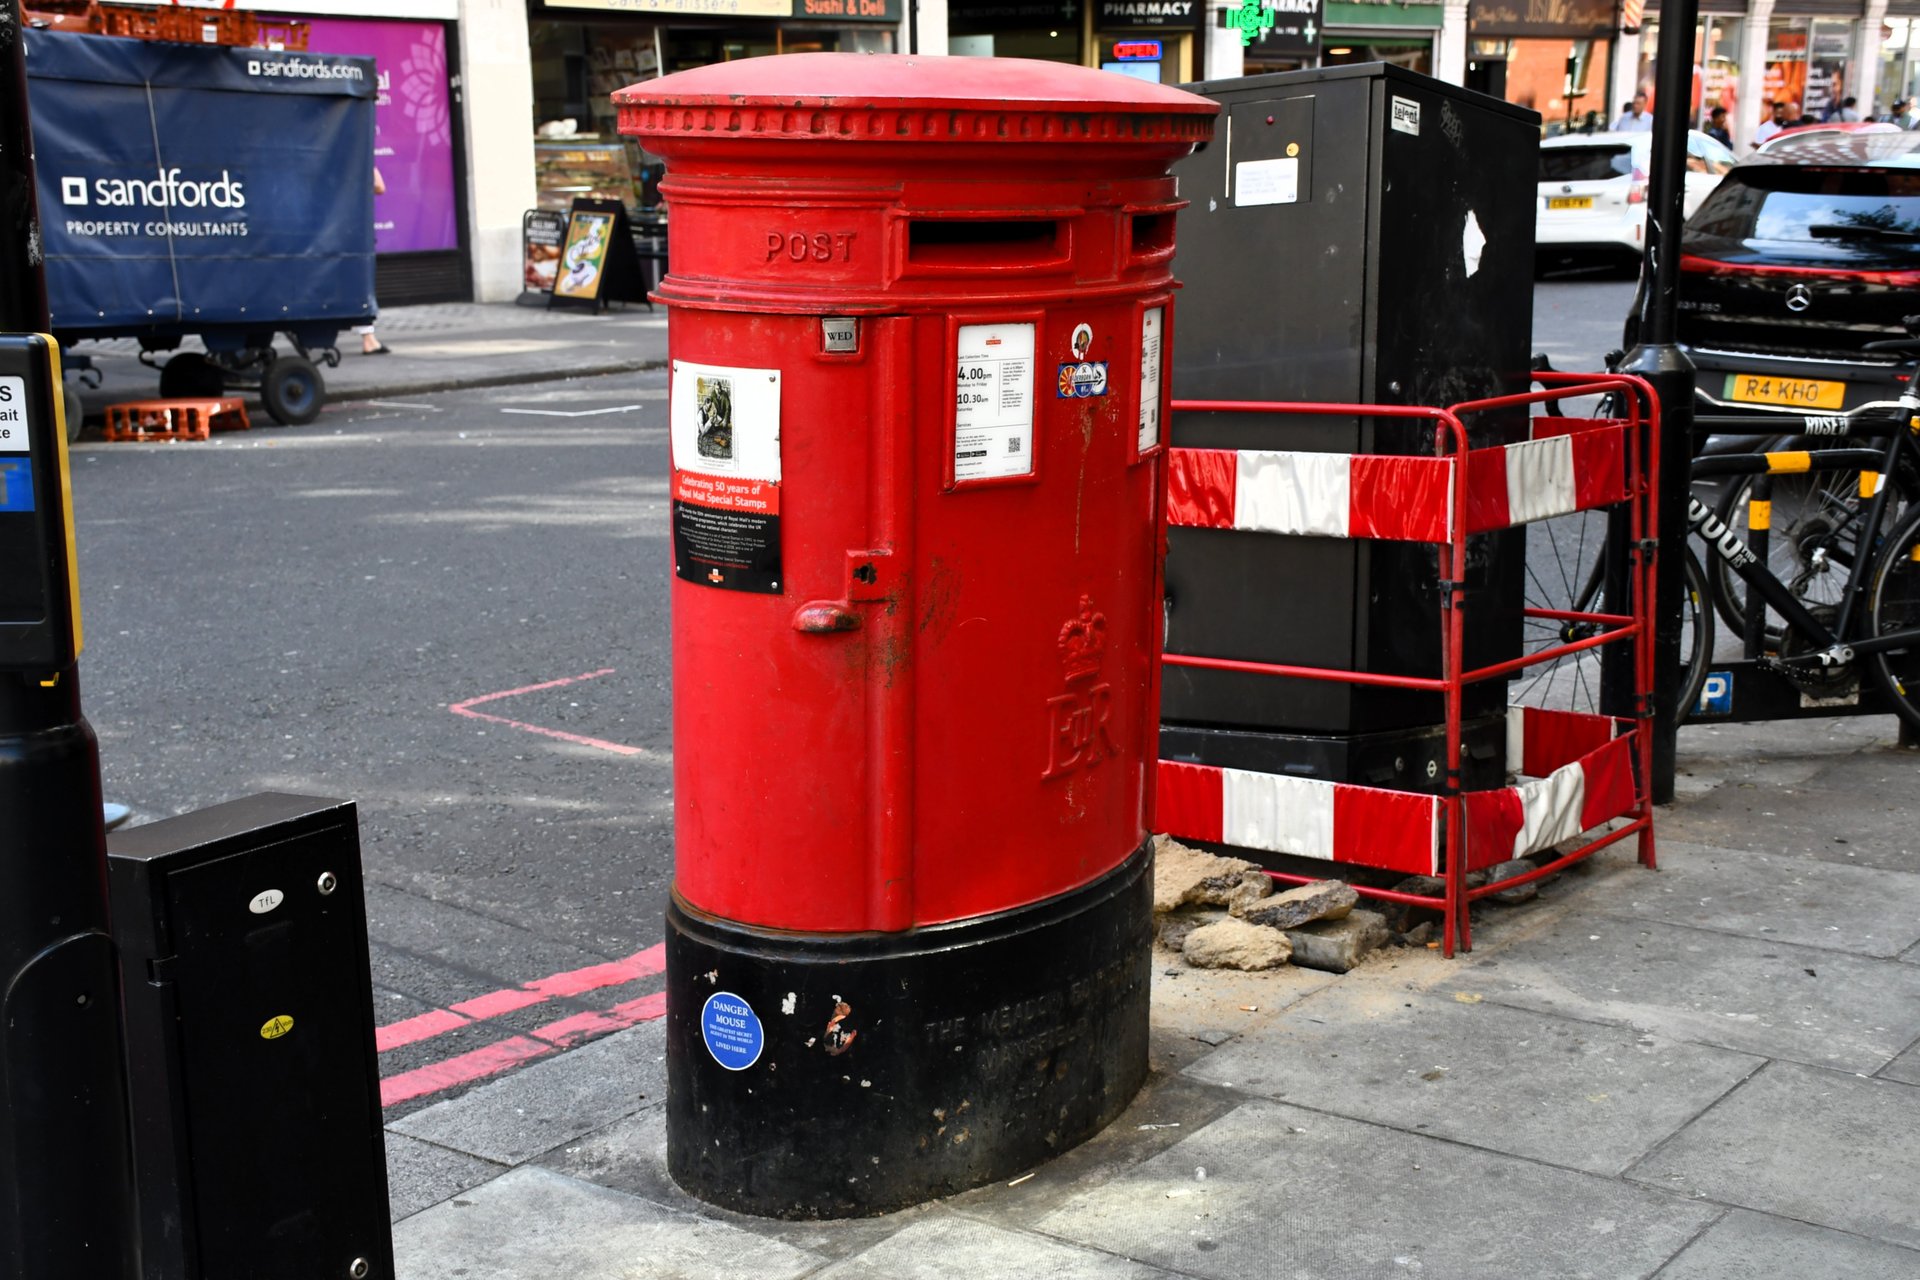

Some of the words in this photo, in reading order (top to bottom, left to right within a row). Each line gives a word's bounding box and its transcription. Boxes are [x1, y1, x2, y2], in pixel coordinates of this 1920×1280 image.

[1104, 2, 1192, 16] PHARMACY
[1113, 43, 1159, 57] OPEN
[262, 57, 364, 81] sandfords.com
[95, 168, 246, 209] sandfords
[66, 221, 140, 236] PROPERTY
[145, 221, 248, 237] CONSULTANTS
[766, 231, 856, 262] POST
[827, 332, 853, 341] WED
[1745, 379, 1770, 396] R4
[1804, 416, 1837, 435] ROSE
[682, 474, 714, 491] Celebrating
[715, 481, 725, 491] 50
[726, 485, 749, 495] years
[751, 485, 761, 495] of
[679, 486, 692, 499] Royal
[693, 489, 705, 501] Mail
[707, 493, 733, 505] Special
[735, 497, 767, 510] Stamps
[1700, 677, 1726, 710] P
[258, 895, 275, 908] TfL
[713, 1000, 749, 1017] DANGER
[716, 1014, 746, 1029] MOUSE
[717, 1026, 736, 1035] GREATEST
[736, 1031, 753, 1039] SECRET
[737, 1036, 753, 1044] WORLD
[715, 1041, 731, 1051] LIVED
[731, 1045, 747, 1054] HERE
